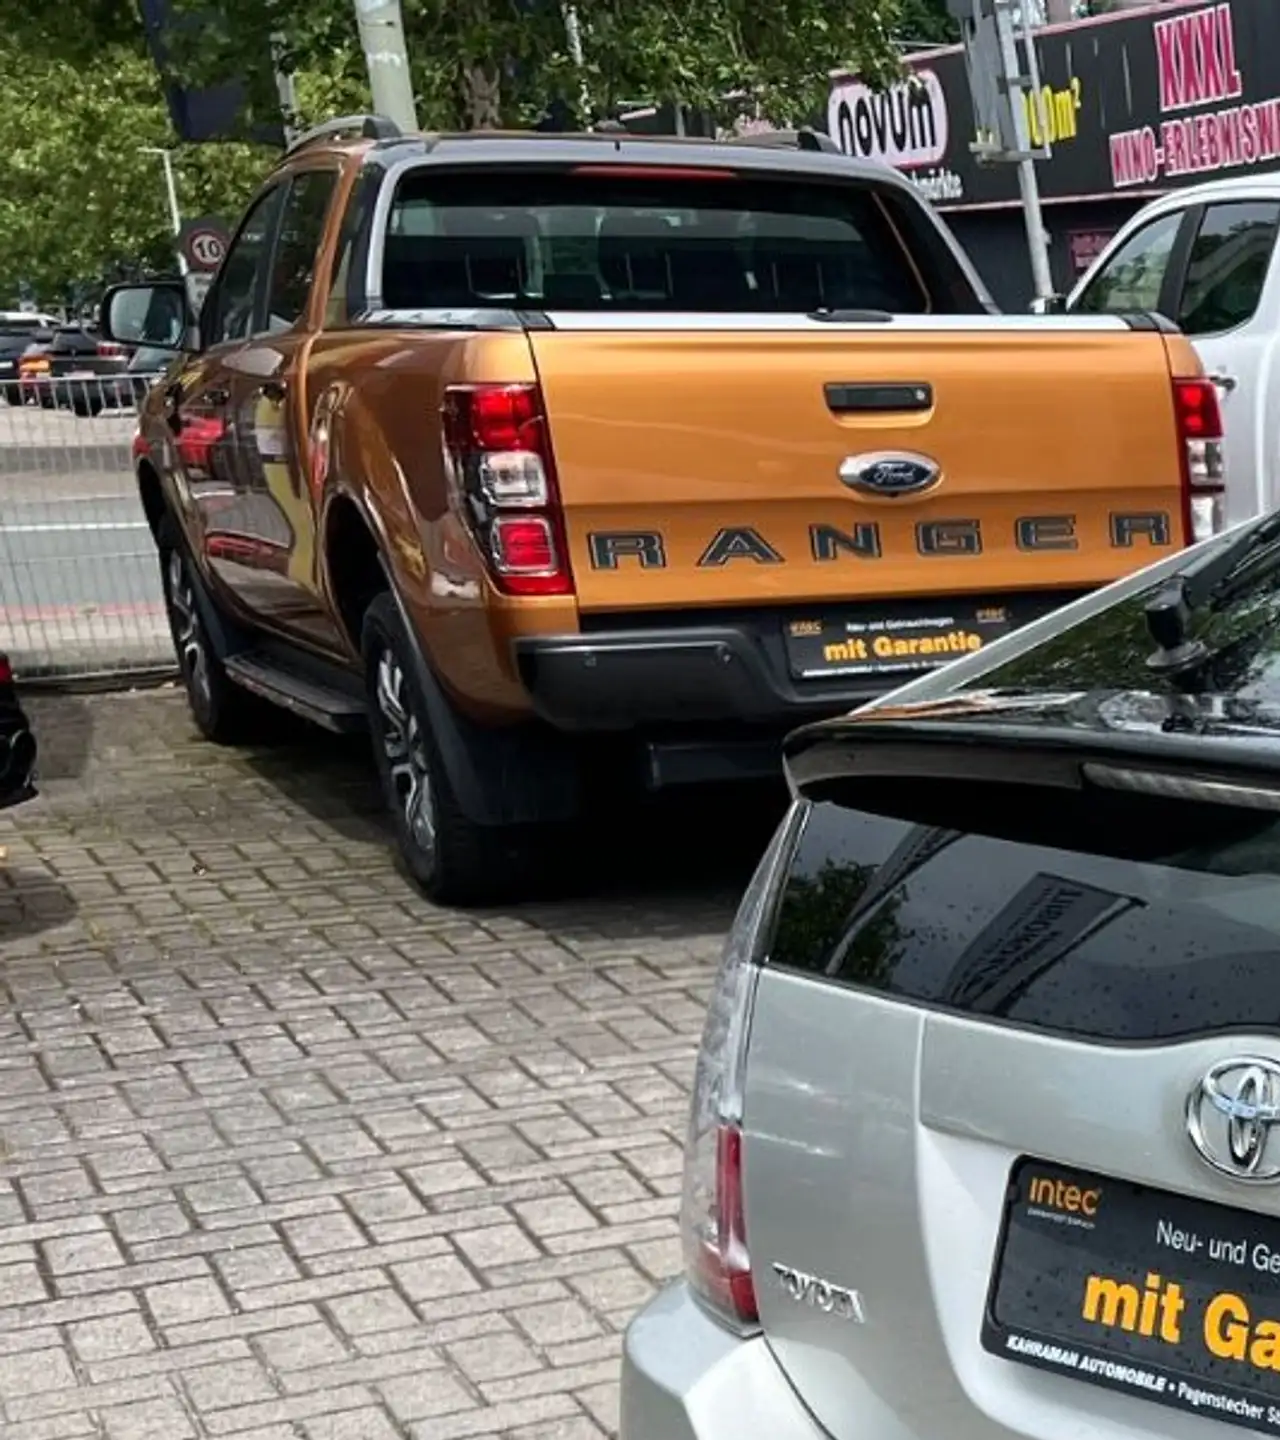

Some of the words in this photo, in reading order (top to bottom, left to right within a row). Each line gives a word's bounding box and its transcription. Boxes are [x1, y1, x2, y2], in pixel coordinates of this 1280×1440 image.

[1153, 3, 1242, 112] XXXL
[837, 82, 938, 157] novum
[195, 239, 220, 258] 10
[586, 510, 1172, 570] RANGER
[824, 638, 868, 662] mit
[873, 630, 981, 658] Garantie
[1029, 1177, 1098, 1216] intec
[1156, 1219, 1204, 1254] Neu-
[1209, 1242, 1248, 1265] und
[1082, 1272, 1185, 1345] mit
[1005, 1334, 1079, 1369] KAHRAMAN
[1079, 1354, 1167, 1393] AUTOMOBILE
[1178, 1381, 1264, 1421] Pagenstecher
